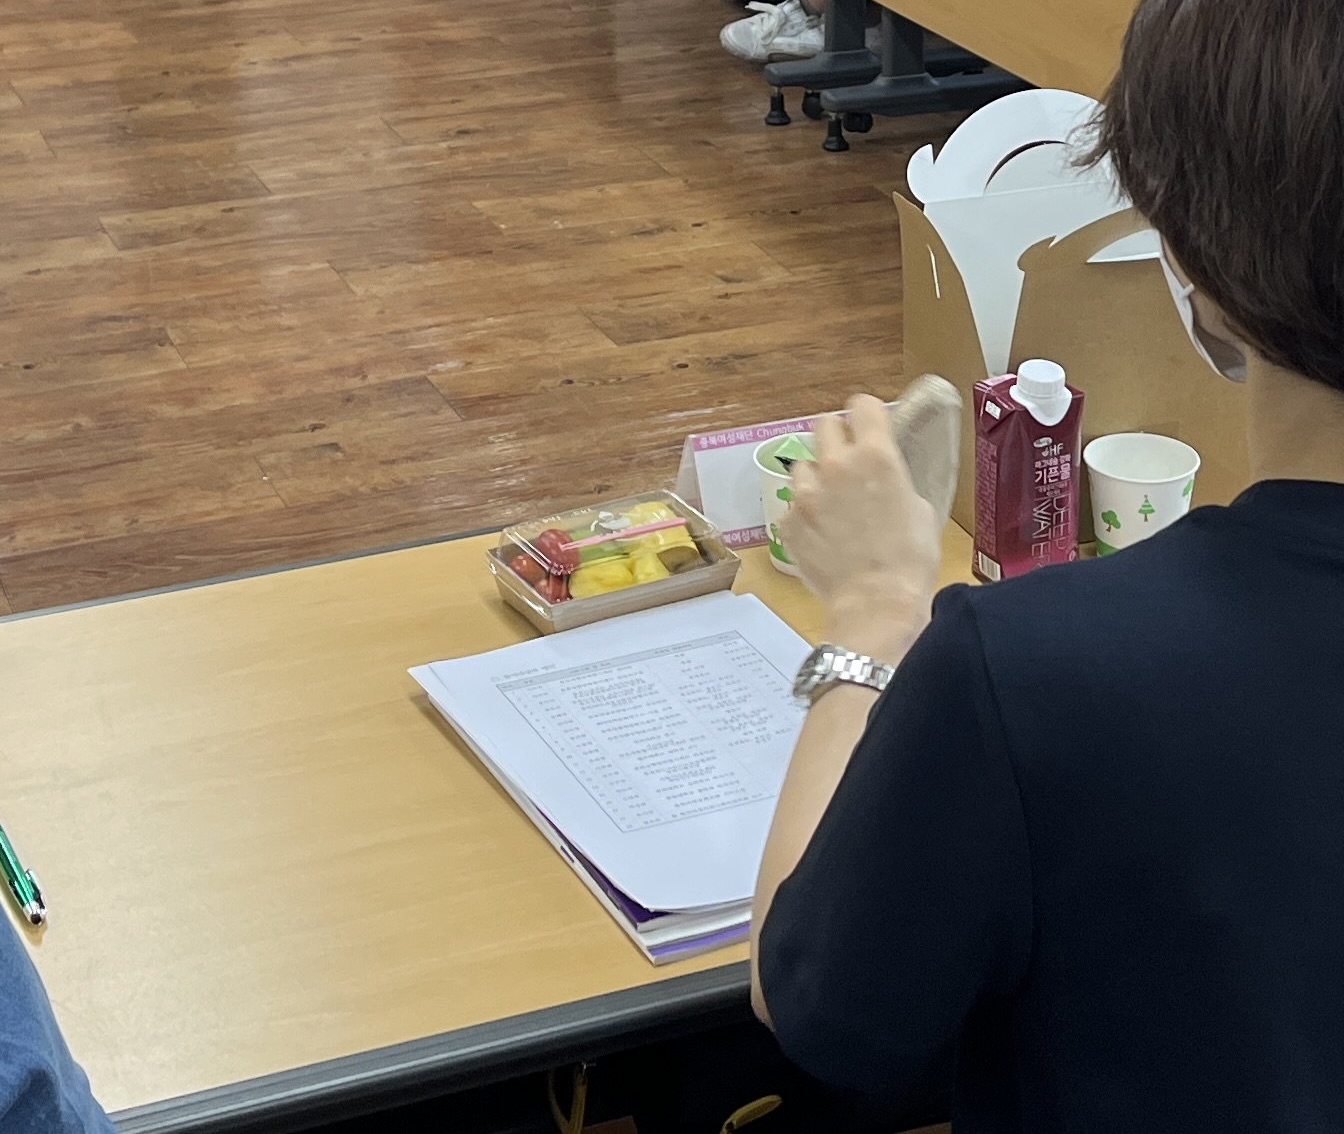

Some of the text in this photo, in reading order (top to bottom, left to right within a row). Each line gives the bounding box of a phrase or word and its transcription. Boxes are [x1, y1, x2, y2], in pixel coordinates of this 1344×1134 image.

[699, 431, 753, 449] 충북여성재단
[756, 421, 805, 439] Chungbuk
[1053, 493, 1072, 550] DEEP
